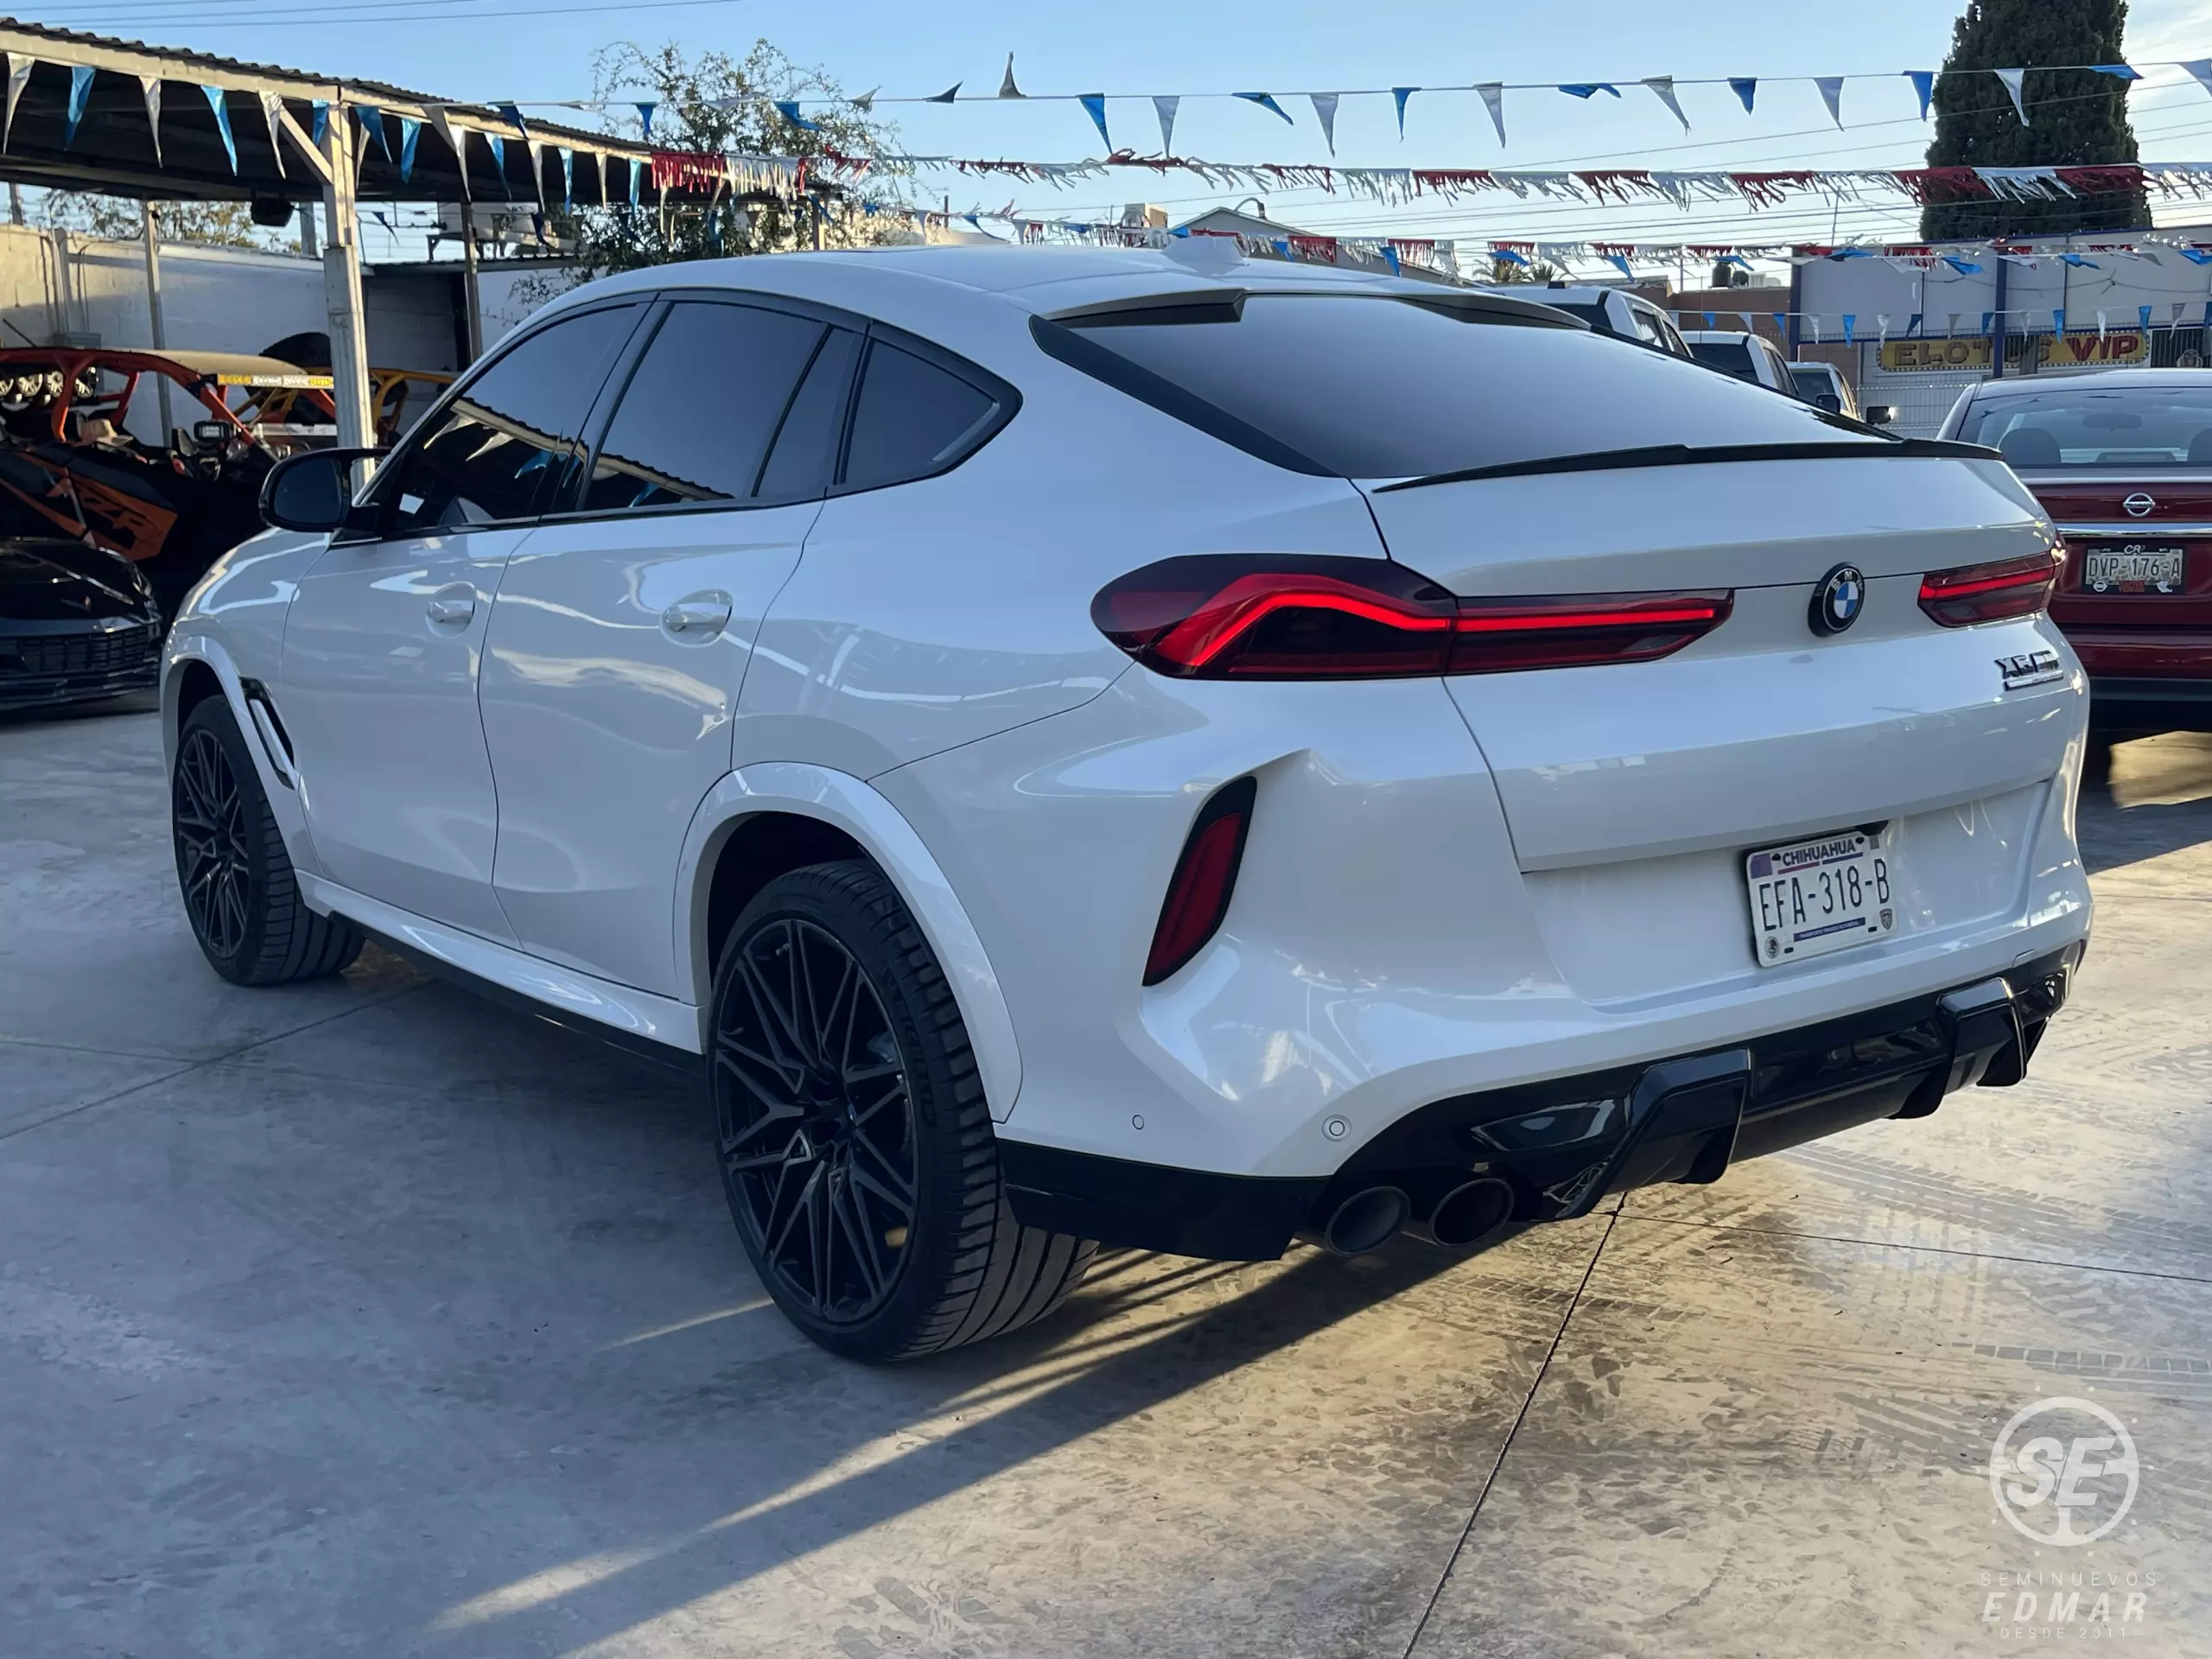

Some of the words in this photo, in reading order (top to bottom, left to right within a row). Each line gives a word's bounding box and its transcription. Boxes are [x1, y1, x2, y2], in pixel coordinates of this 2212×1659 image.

[1894, 335, 2053, 366] ELOTS
[2067, 334, 2139, 362] VIP
[1831, 570, 1864, 591] BMW
[2089, 556, 2180, 577] DVP-176-A
[1782, 839, 1856, 867] CHIHUAHUA
[1758, 858, 1890, 931] EFA-318-B
